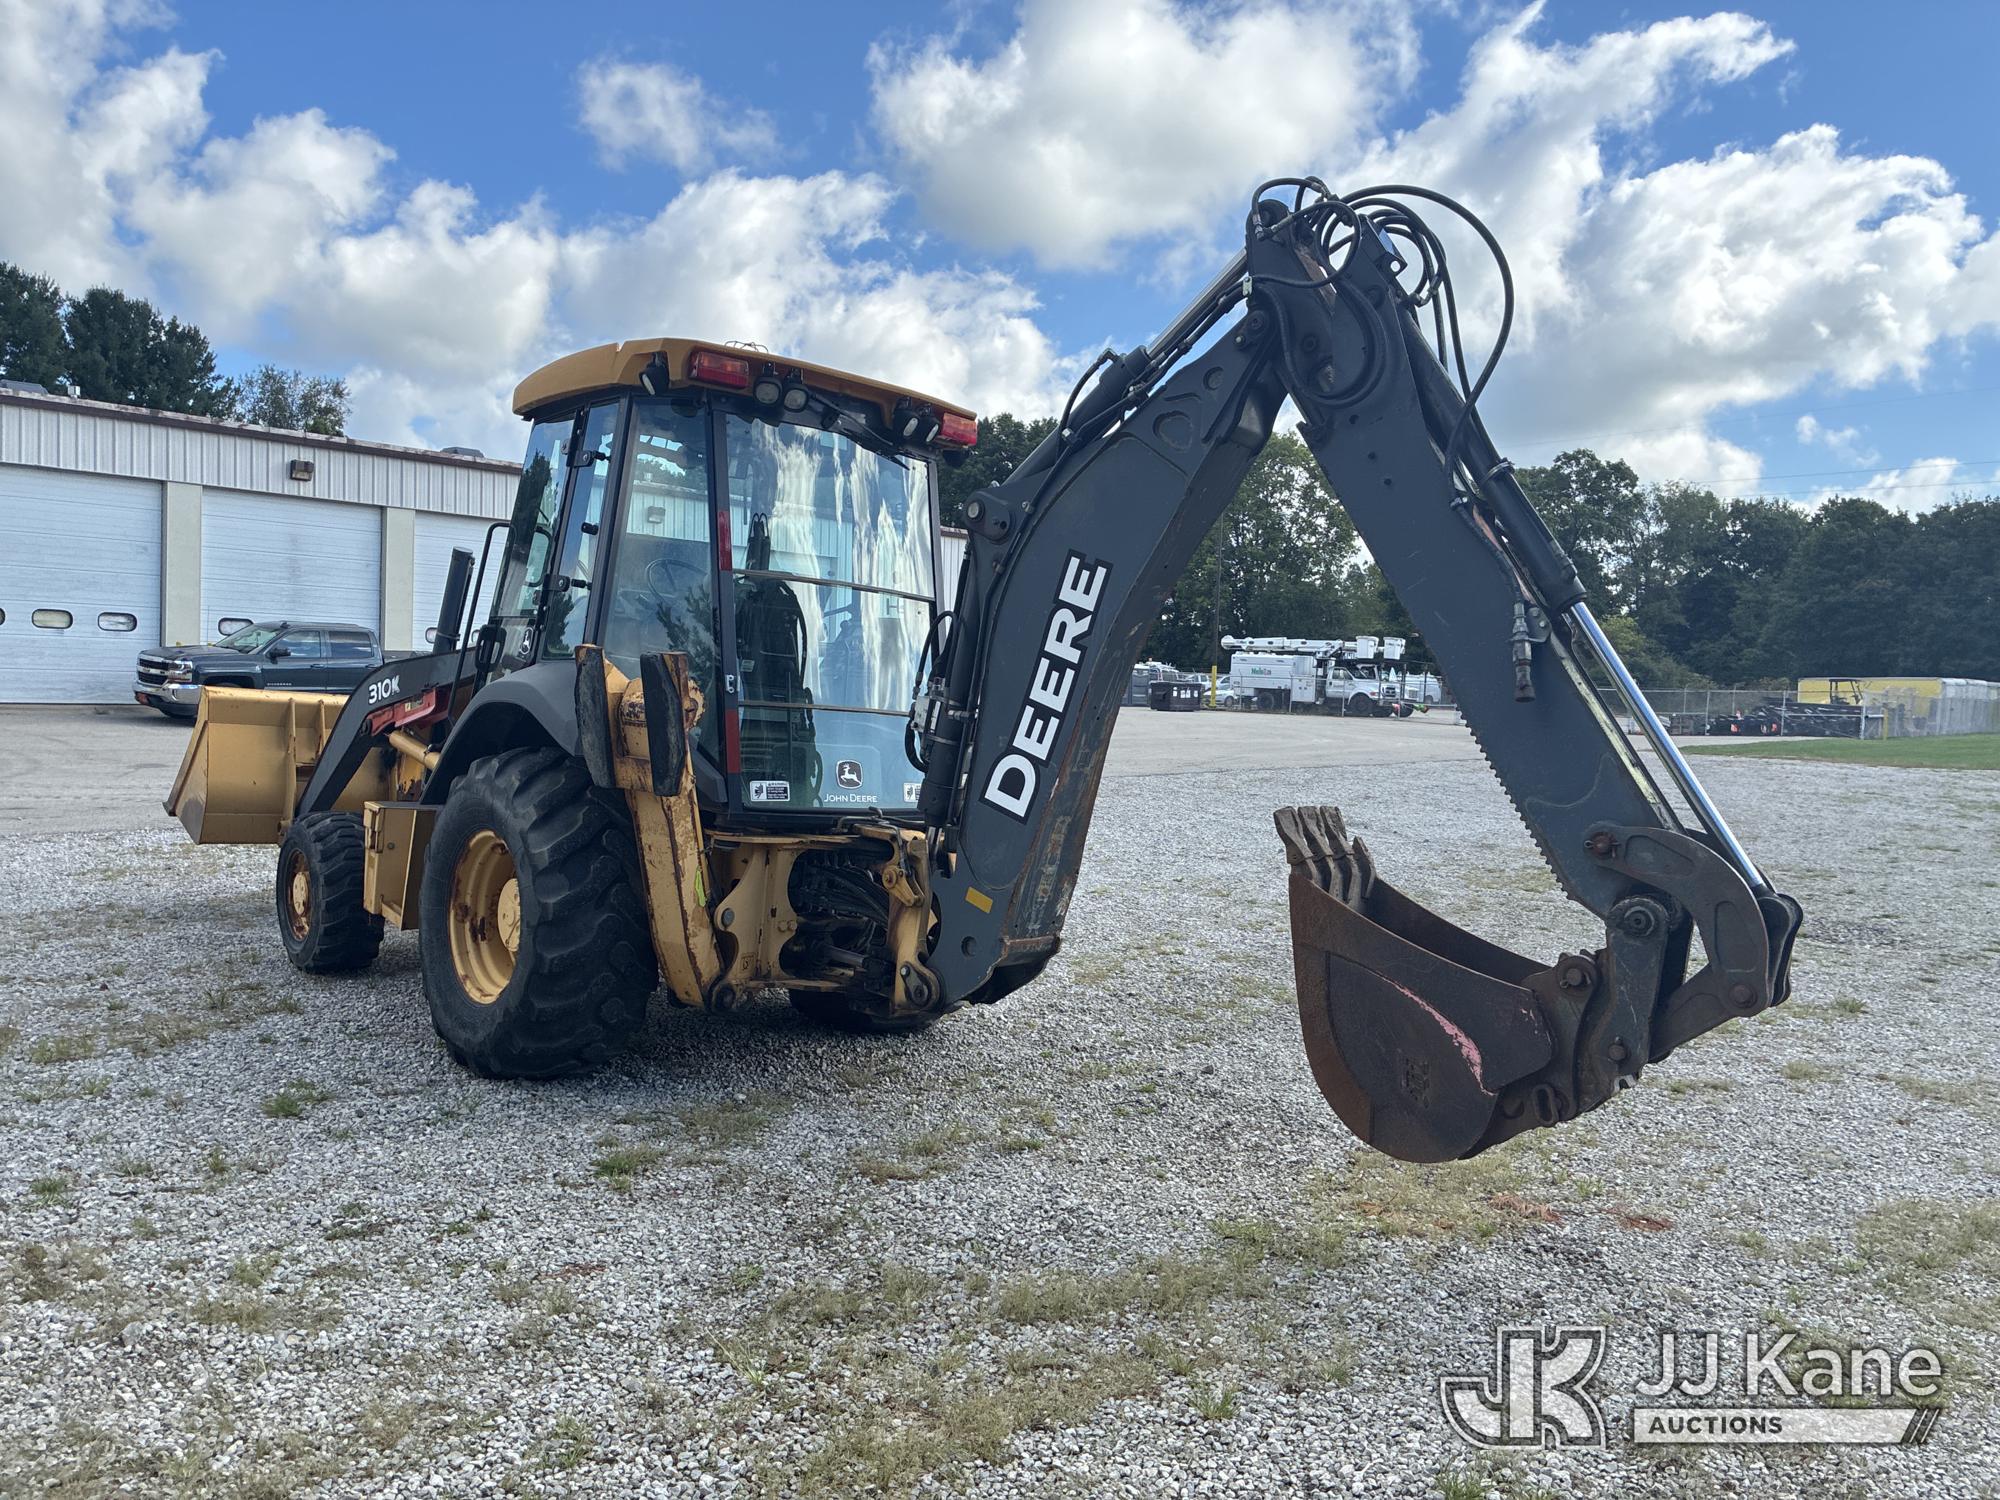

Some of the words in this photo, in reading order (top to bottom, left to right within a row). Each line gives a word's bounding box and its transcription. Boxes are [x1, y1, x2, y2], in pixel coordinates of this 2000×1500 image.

[369, 674, 401, 704] 310K
[984, 556, 1107, 817] DEERE
[824, 793, 849, 802] JOHN
[849, 793, 878, 803] DEERE
